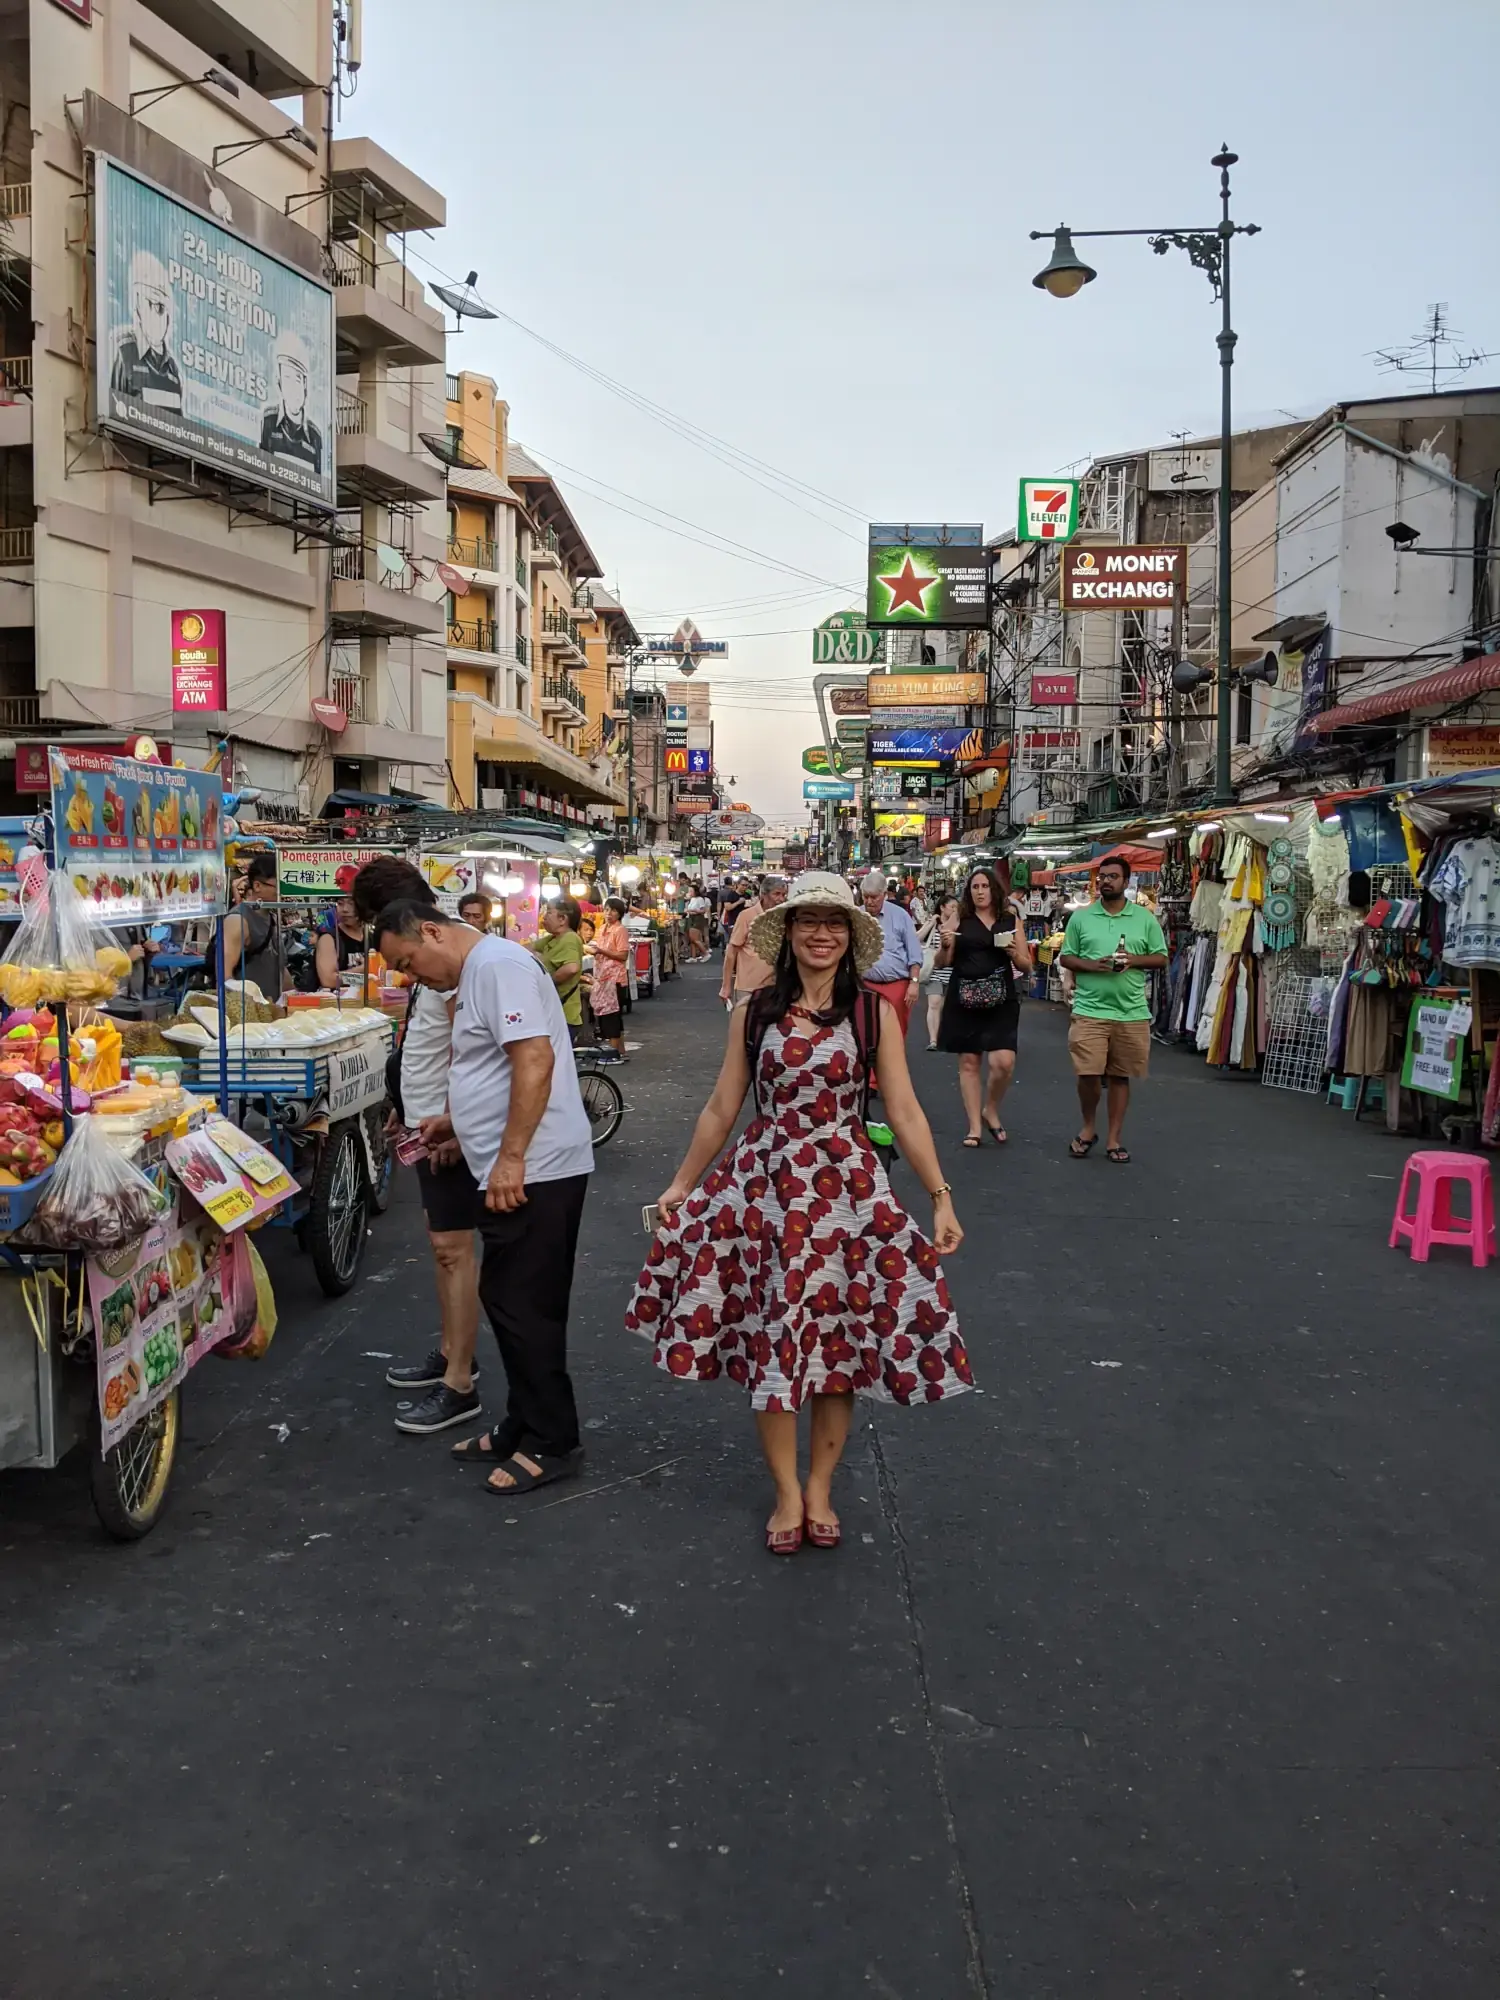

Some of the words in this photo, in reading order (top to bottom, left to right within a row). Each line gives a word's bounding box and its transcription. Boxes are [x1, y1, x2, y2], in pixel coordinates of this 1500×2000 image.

[183, 229, 263, 296] 24-HOUR
[168, 259, 278, 338] PROTECTION
[206, 315, 245, 356] AND
[180, 338, 269, 402] SERVICES
[127, 404, 205, 446] Chanasongkram
[207, 437, 235, 457] Police
[237, 448, 268, 471] Station
[1033, 489, 1067, 538] 7
[1105, 554, 1178, 573] MONEY
[816, 630, 874, 662] D&D
[176, 680, 213, 689] EXCHANGE
[902, 682, 928, 695] YUM
[932, 680, 965, 694] KUNG
[181, 691, 207, 705] ATM
[80, 754, 100, 769] Fresh
[905, 775, 927, 784] JACK
[282, 849, 353, 866] Pomegranate
[283, 869, 330, 884] 石榴汁
[1421, 1013, 1437, 1025] HAND
[1438, 1015, 1448, 1025] MA
[340, 1051, 369, 1082] DURIAN
[333, 1078, 360, 1112] SWEET
[364, 1067, 385, 1096] FRUIT
